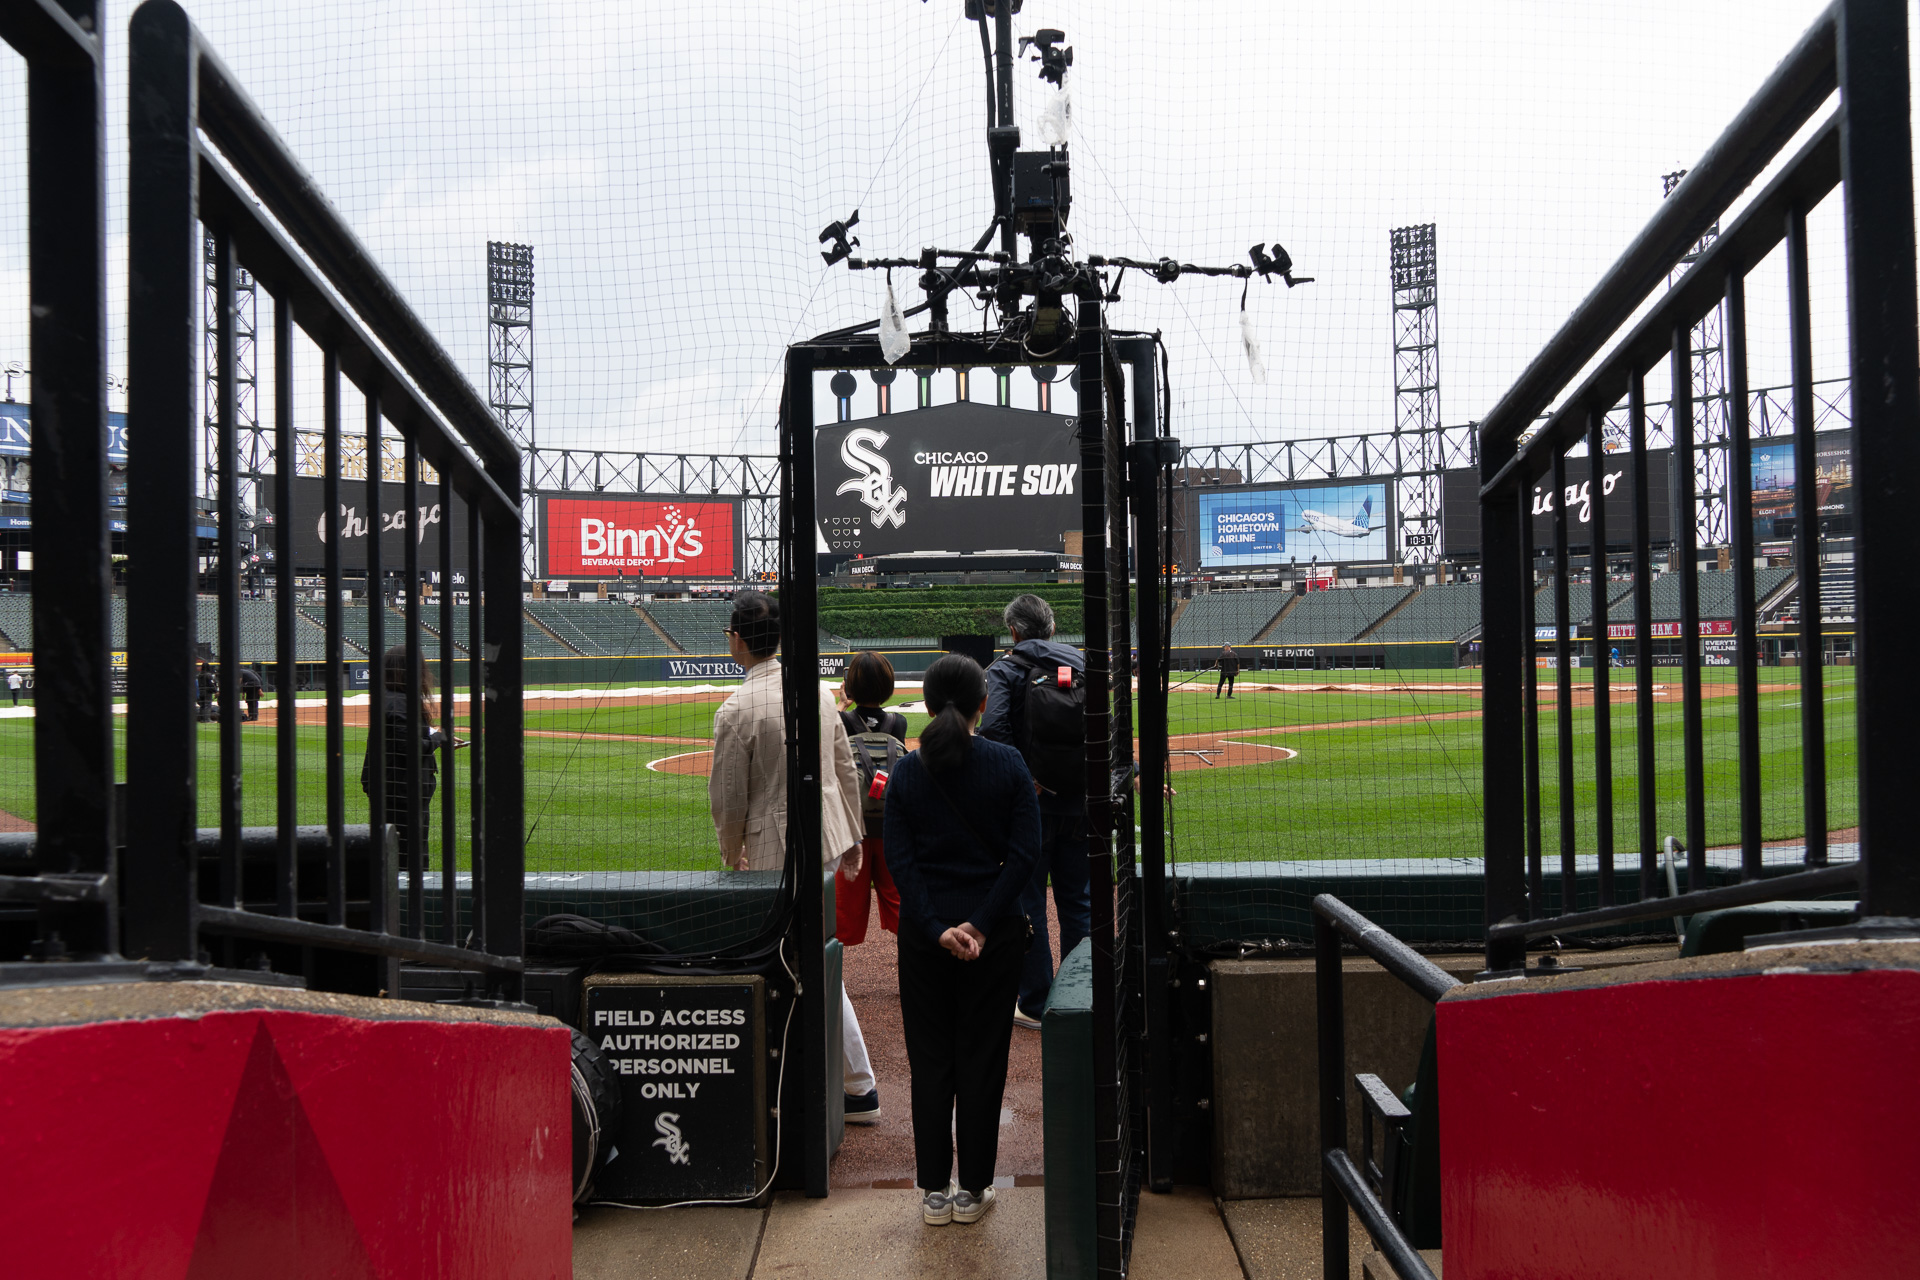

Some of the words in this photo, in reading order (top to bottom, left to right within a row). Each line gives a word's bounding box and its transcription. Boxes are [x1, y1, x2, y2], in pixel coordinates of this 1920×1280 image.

[914, 451, 989, 464] CHICAGO
[930, 464, 1018, 497] WHITE
[1021, 463, 1078, 496] SOX
[1532, 470, 1622, 523] icago
[1817, 503, 1845, 511] AMMOND
[1217, 512, 1275, 523] CHICAGO'S
[1217, 522, 1279, 534] HOMETOWN
[1217, 533, 1256, 544] AIRLINE
[1410, 535, 1433, 545] 10:37
[581, 558, 626, 566] BEVERAGE
[626, 558, 655, 567] DEPOT
[1060, 561, 1070, 570] FAN
[851, 567, 862, 575] FAN
[862, 565, 875, 574] DECK
[431, 571, 466, 585] Melo
[761, 571, 777, 581] 2:15
[1263, 649, 1283, 658] THE
[1285, 648, 1315, 657] PATIO
[819, 658, 844, 667] REAM
[1705, 654, 1731, 665] Rate
[668, 660, 745, 676] WINTRUS
[594, 1010, 655, 1026] FIELD
[660, 1009, 746, 1026] ACCESS
[600, 1033, 741, 1050] AUTHORIZED
[608, 1058, 735, 1075] PERSONNEL
[640, 1082, 701, 1099] ONLY
